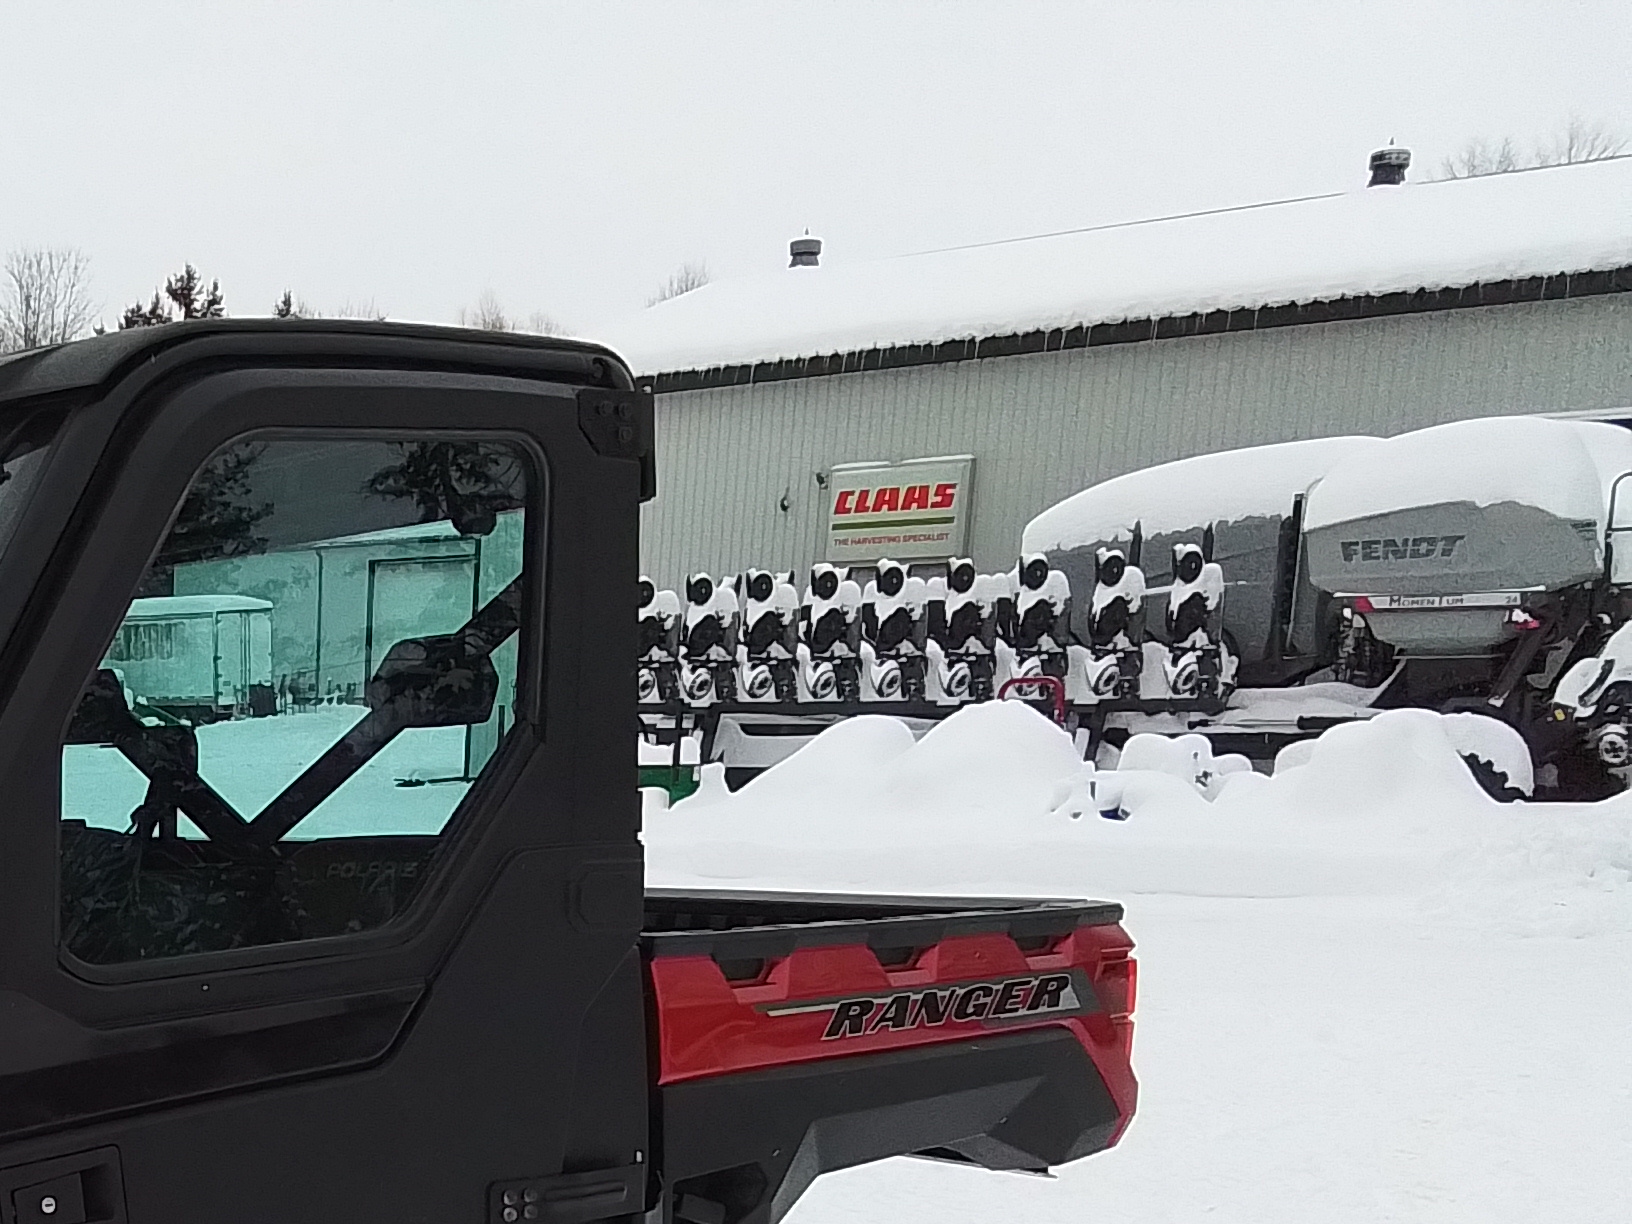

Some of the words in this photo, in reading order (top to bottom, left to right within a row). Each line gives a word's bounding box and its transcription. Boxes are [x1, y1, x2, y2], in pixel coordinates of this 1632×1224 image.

[834, 483, 958, 515] CLAAS
[834, 537, 849, 546] THE
[851, 535, 901, 545] HARVESTING
[903, 533, 949, 542] SPECIALIST
[1340, 534, 1466, 563] FENDT
[820, 973, 1072, 1041] RANGER
